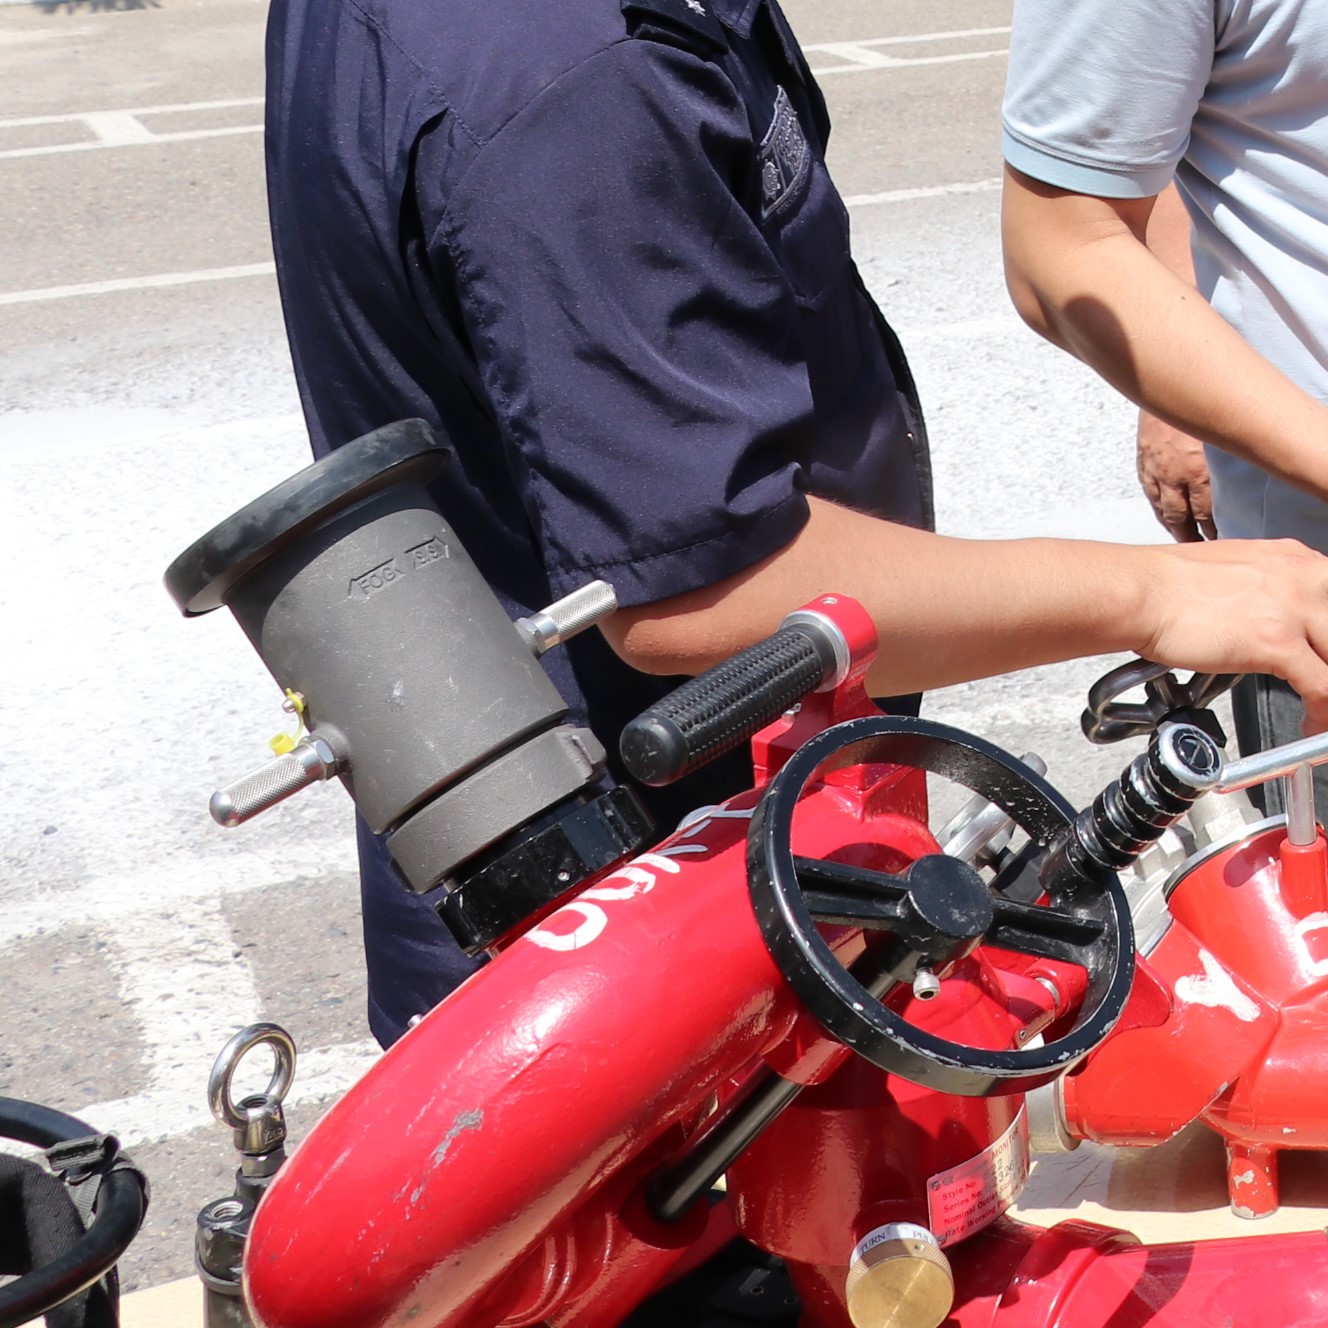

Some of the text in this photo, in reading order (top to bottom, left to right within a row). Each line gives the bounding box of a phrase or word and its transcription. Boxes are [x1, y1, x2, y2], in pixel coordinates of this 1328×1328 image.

[359, 568, 396, 594] FOG
[992, 1127, 1018, 1159] MONITOR
[943, 1187, 964, 1201] Style
[943, 1197, 969, 1212] Series
[944, 1204, 976, 1225] Nominal
[978, 1191, 998, 1208] Outlet
[967, 1208, 996, 1228] Working
[861, 1232, 886, 1255] TURN
